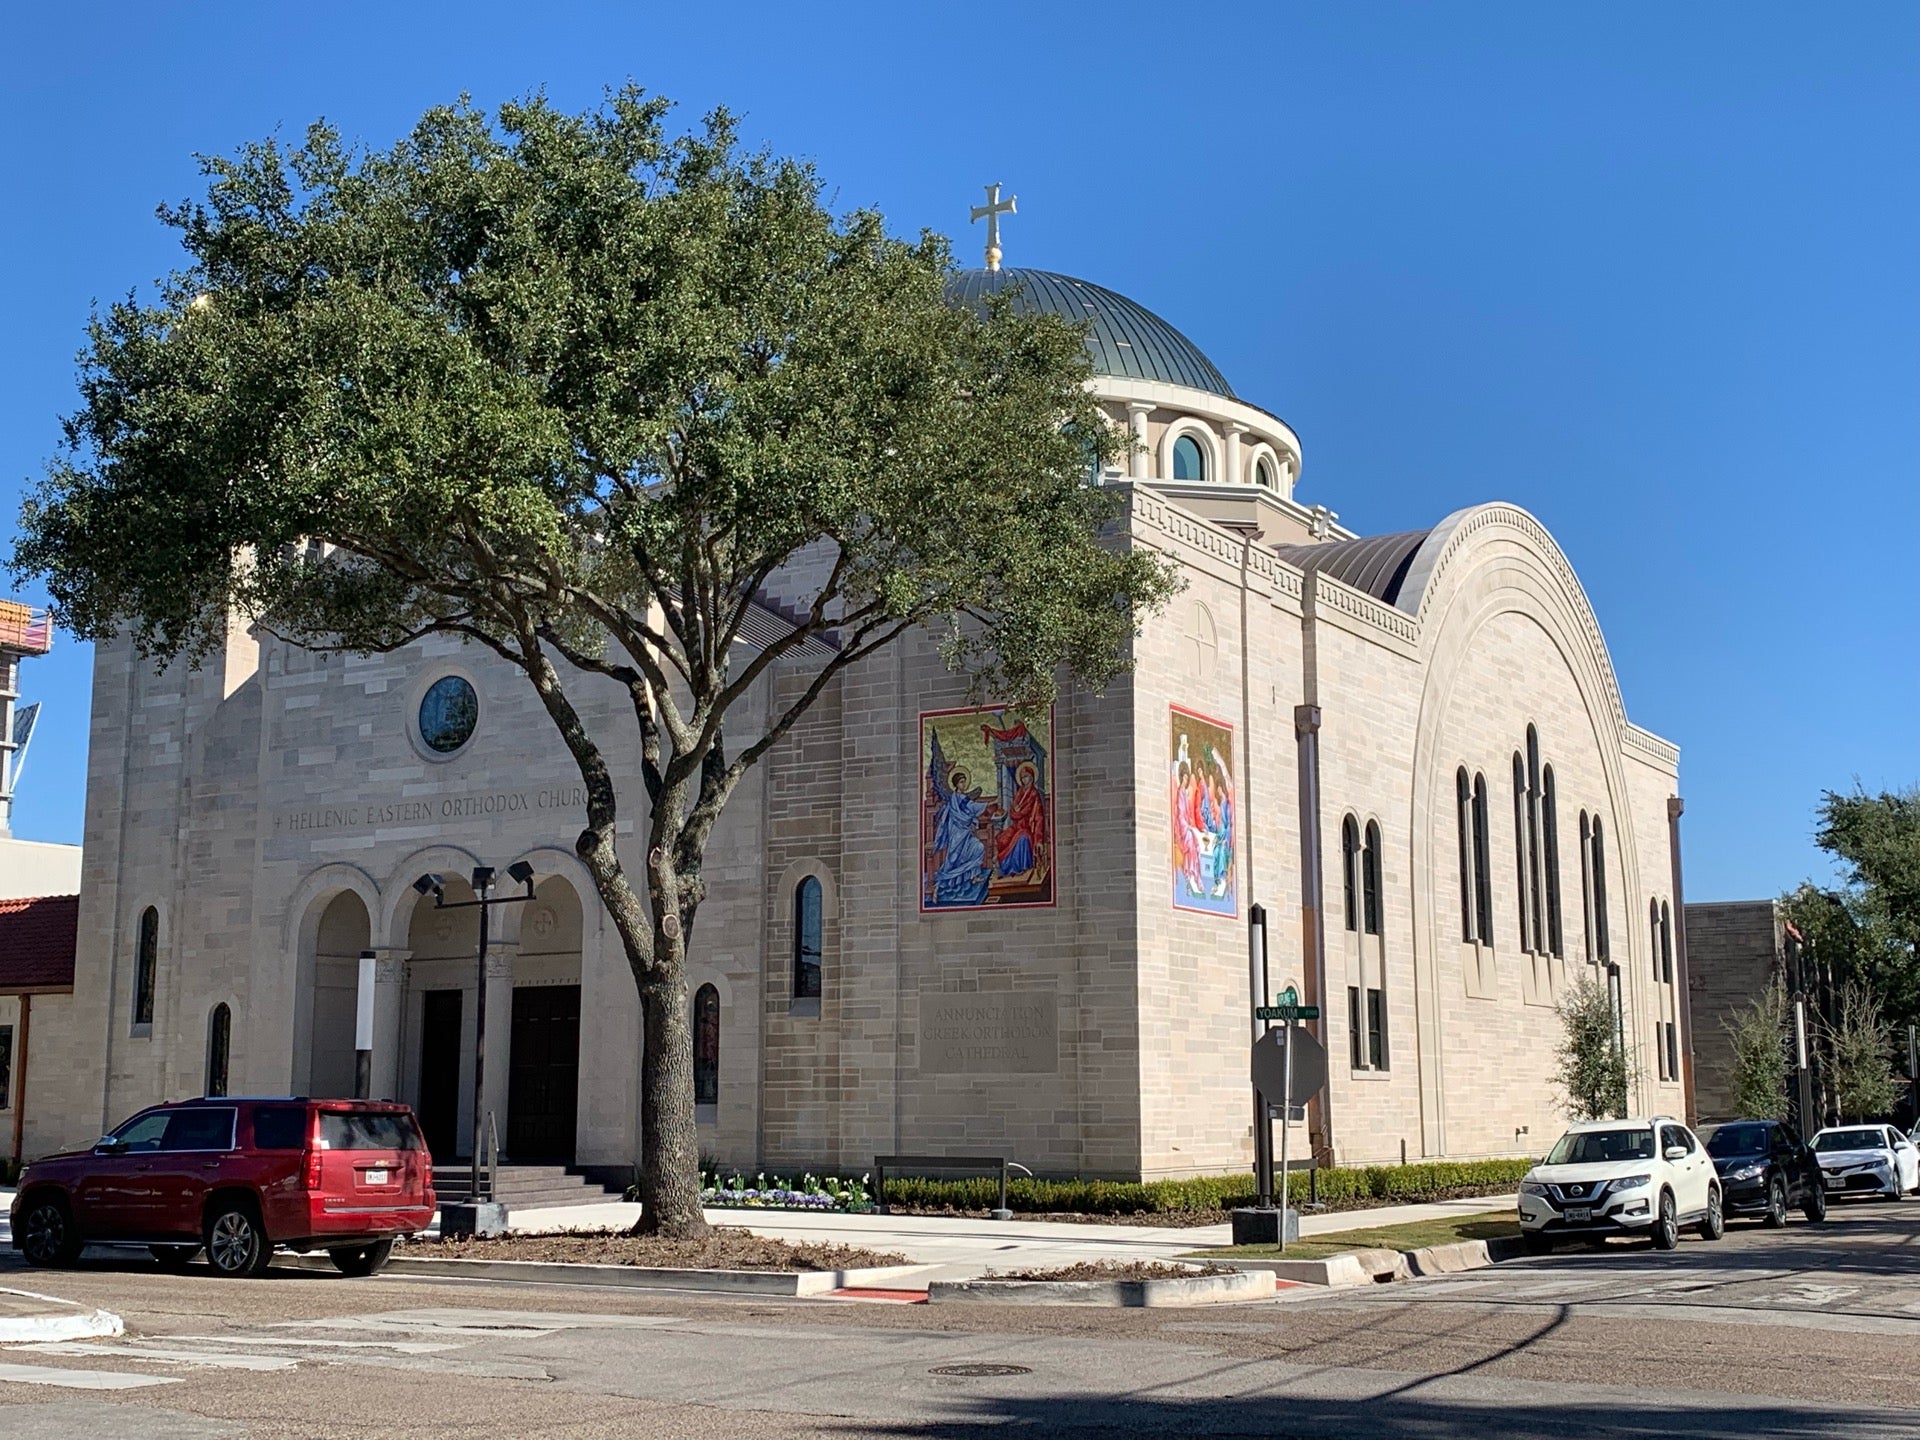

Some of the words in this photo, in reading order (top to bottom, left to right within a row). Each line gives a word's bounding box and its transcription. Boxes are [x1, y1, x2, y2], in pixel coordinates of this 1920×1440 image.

[289, 808, 358, 830] HELLENIC
[367, 801, 432, 824] EASTERN
[441, 793, 529, 817] ORTHODOX
[538, 787, 590, 809] CHURC
[934, 1005, 1044, 1021] ANNUNCIATION
[1258, 1008, 1298, 1019] YOAKUM
[923, 1026, 970, 1041] GREEK
[972, 1025, 1053, 1040] ORTHODOX
[945, 1046, 1030, 1060] CATHEDRAL
